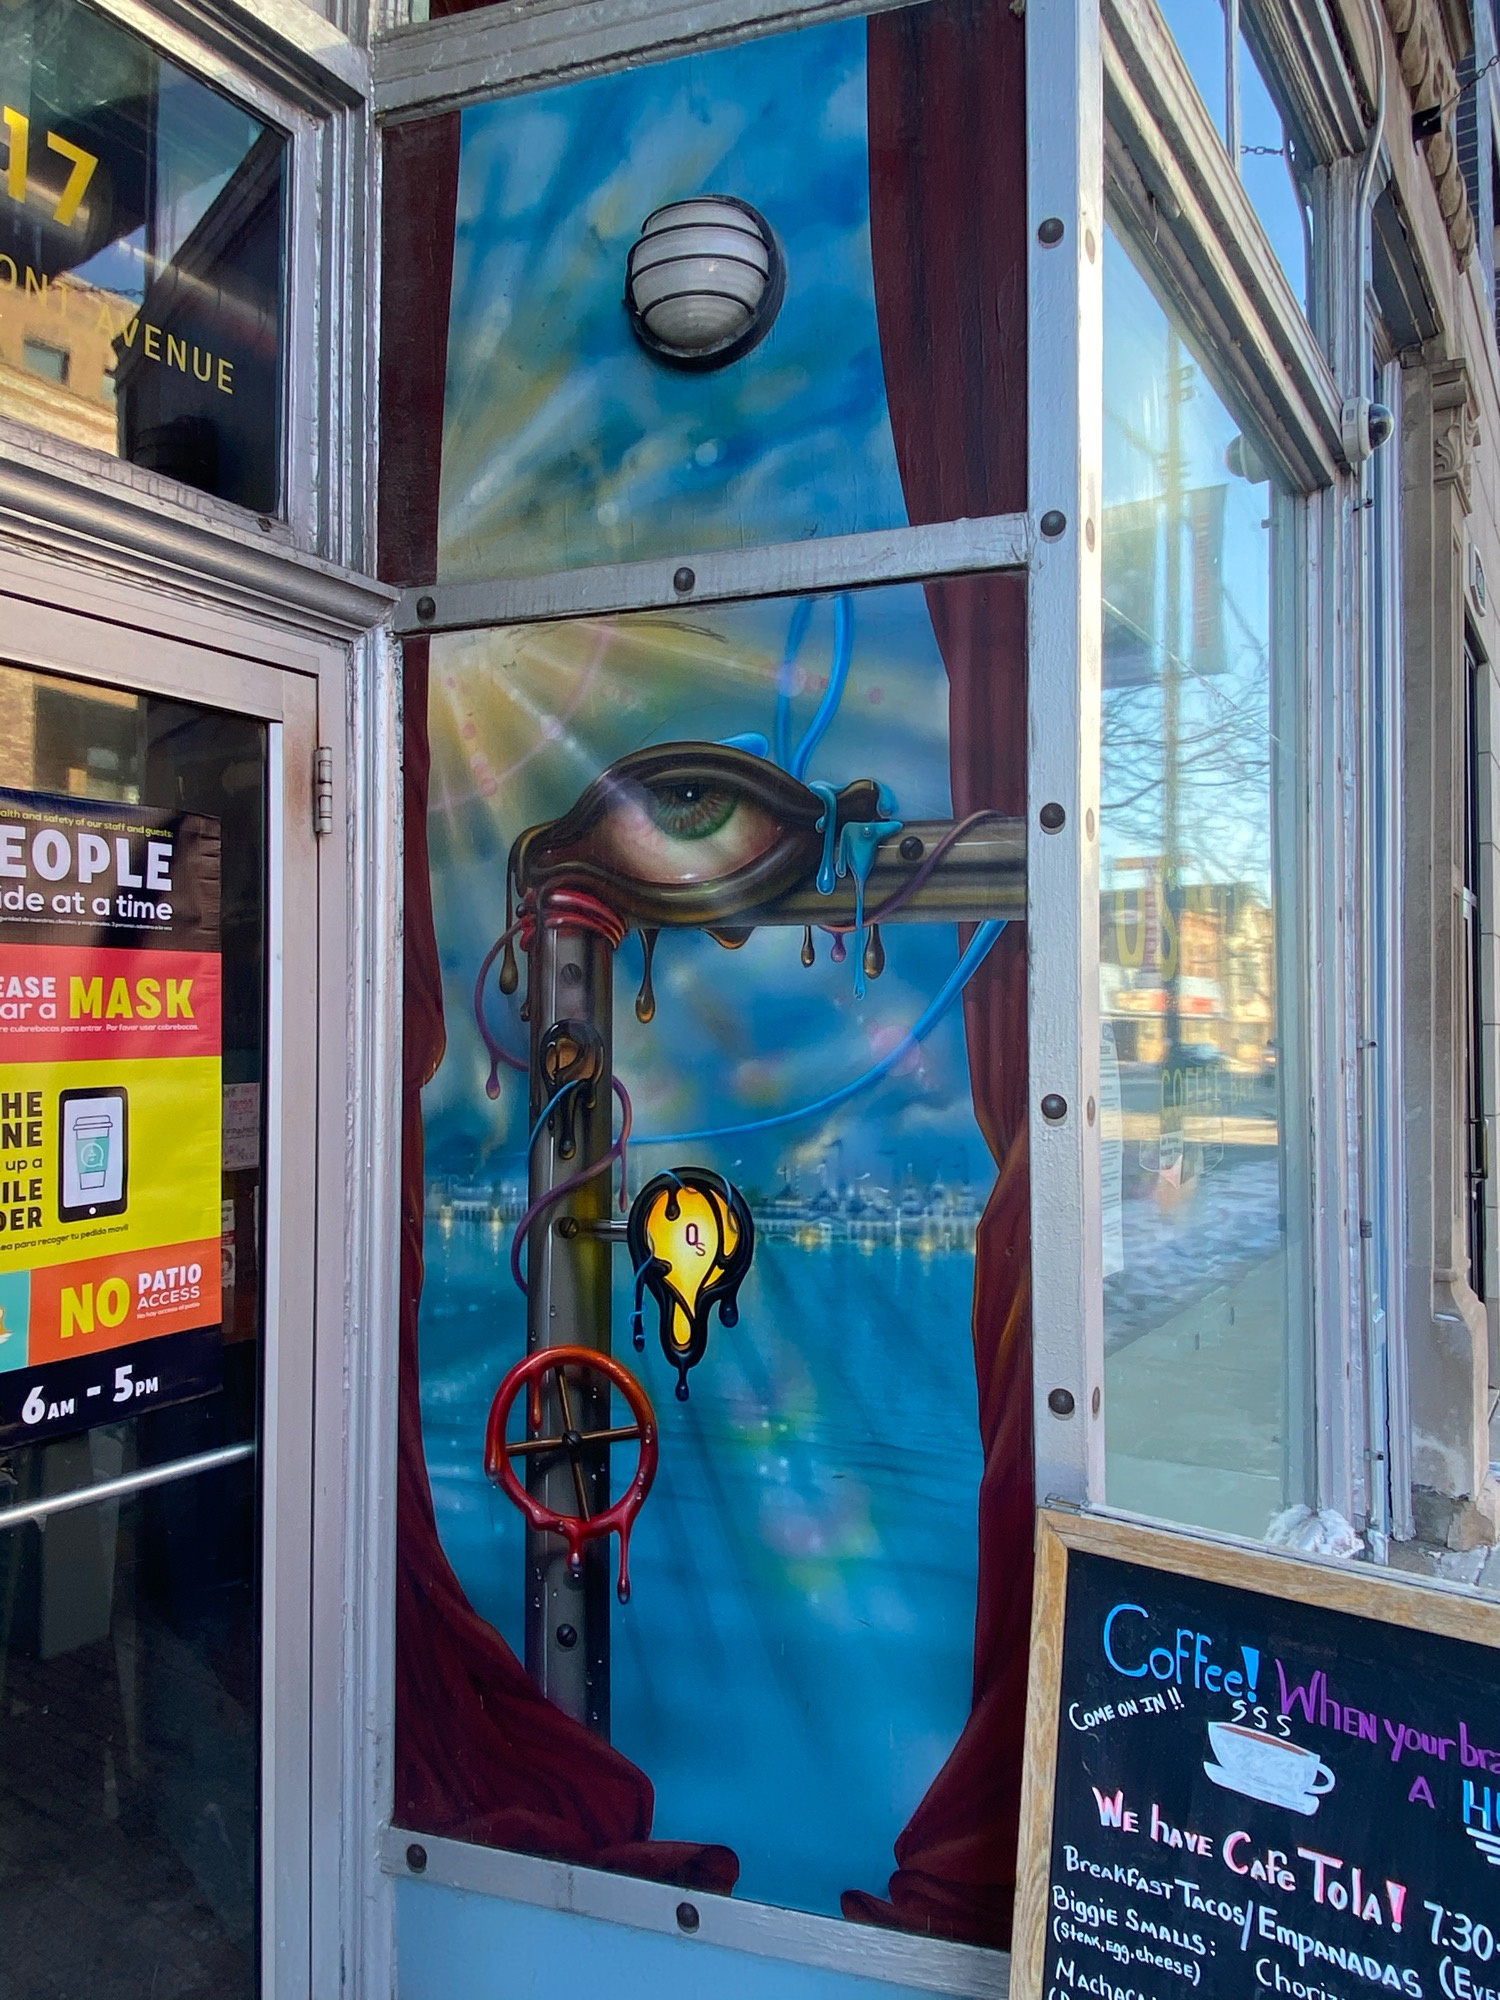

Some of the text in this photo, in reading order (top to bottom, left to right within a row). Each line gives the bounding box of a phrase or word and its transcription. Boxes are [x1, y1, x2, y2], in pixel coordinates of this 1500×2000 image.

[3, 105, 99, 227] 17
[96, 301, 235, 395] AVENUE
[22, 811, 42, 821] and
[43, 814, 75, 827] safety
[75, 817, 86, 827] of
[86, 820, 102, 829] our
[103, 822, 126, 832] staff
[126, 825, 145, 834] and
[0, 824, 174, 893] EOPLE
[51, 891, 86, 915] at
[91, 897, 111, 916] a
[116, 893, 174, 921] time
[38, 1003, 57, 1020] a
[69, 976, 196, 1020] MASK
[1, 1091, 43, 1120] HE
[2, 1121, 43, 1150] NE
[5, 1158, 43, 1174] up a
[38, 1234, 70, 1246] recoger
[138, 1263, 202, 1295] PATIO
[60, 1277, 131, 1339] NO
[136, 1286, 201, 1311] ACCESS
[1068, 1702, 1116, 1731] COME
[1117, 1699, 1140, 1718] ON
[1408, 1775, 1436, 1809] A
